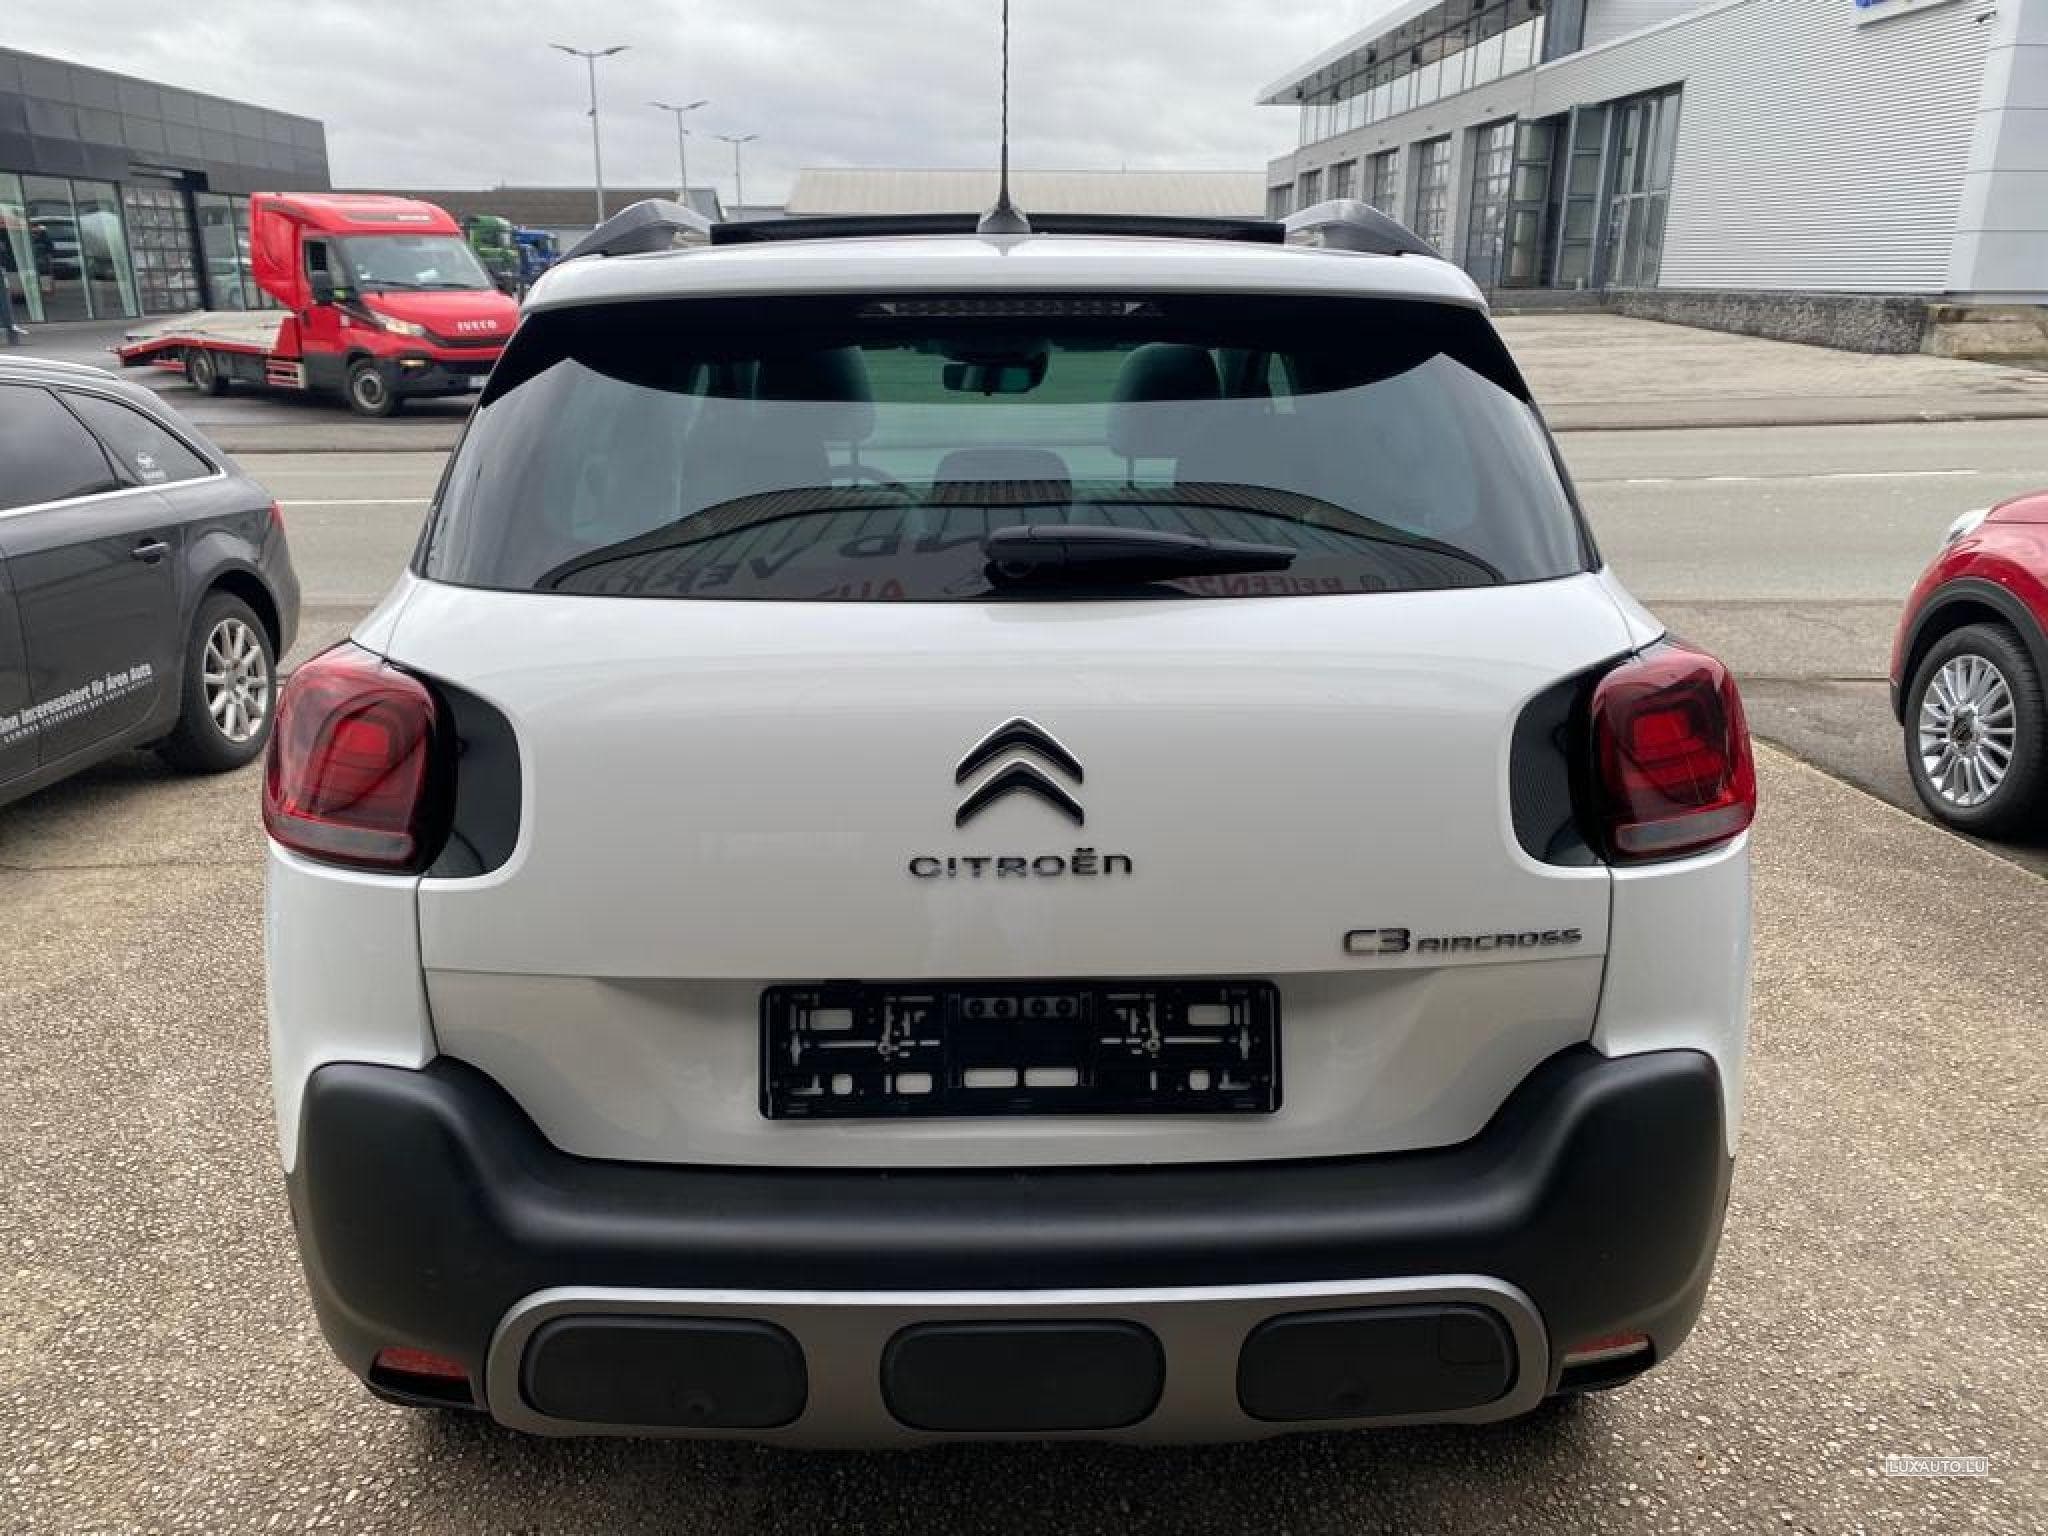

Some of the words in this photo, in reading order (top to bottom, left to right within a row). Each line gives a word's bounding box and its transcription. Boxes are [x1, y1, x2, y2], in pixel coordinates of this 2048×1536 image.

[456, 319, 498, 331] IVECO
[1343, 927, 1411, 955] C3
[1416, 928, 1583, 953] AIRCROSS
